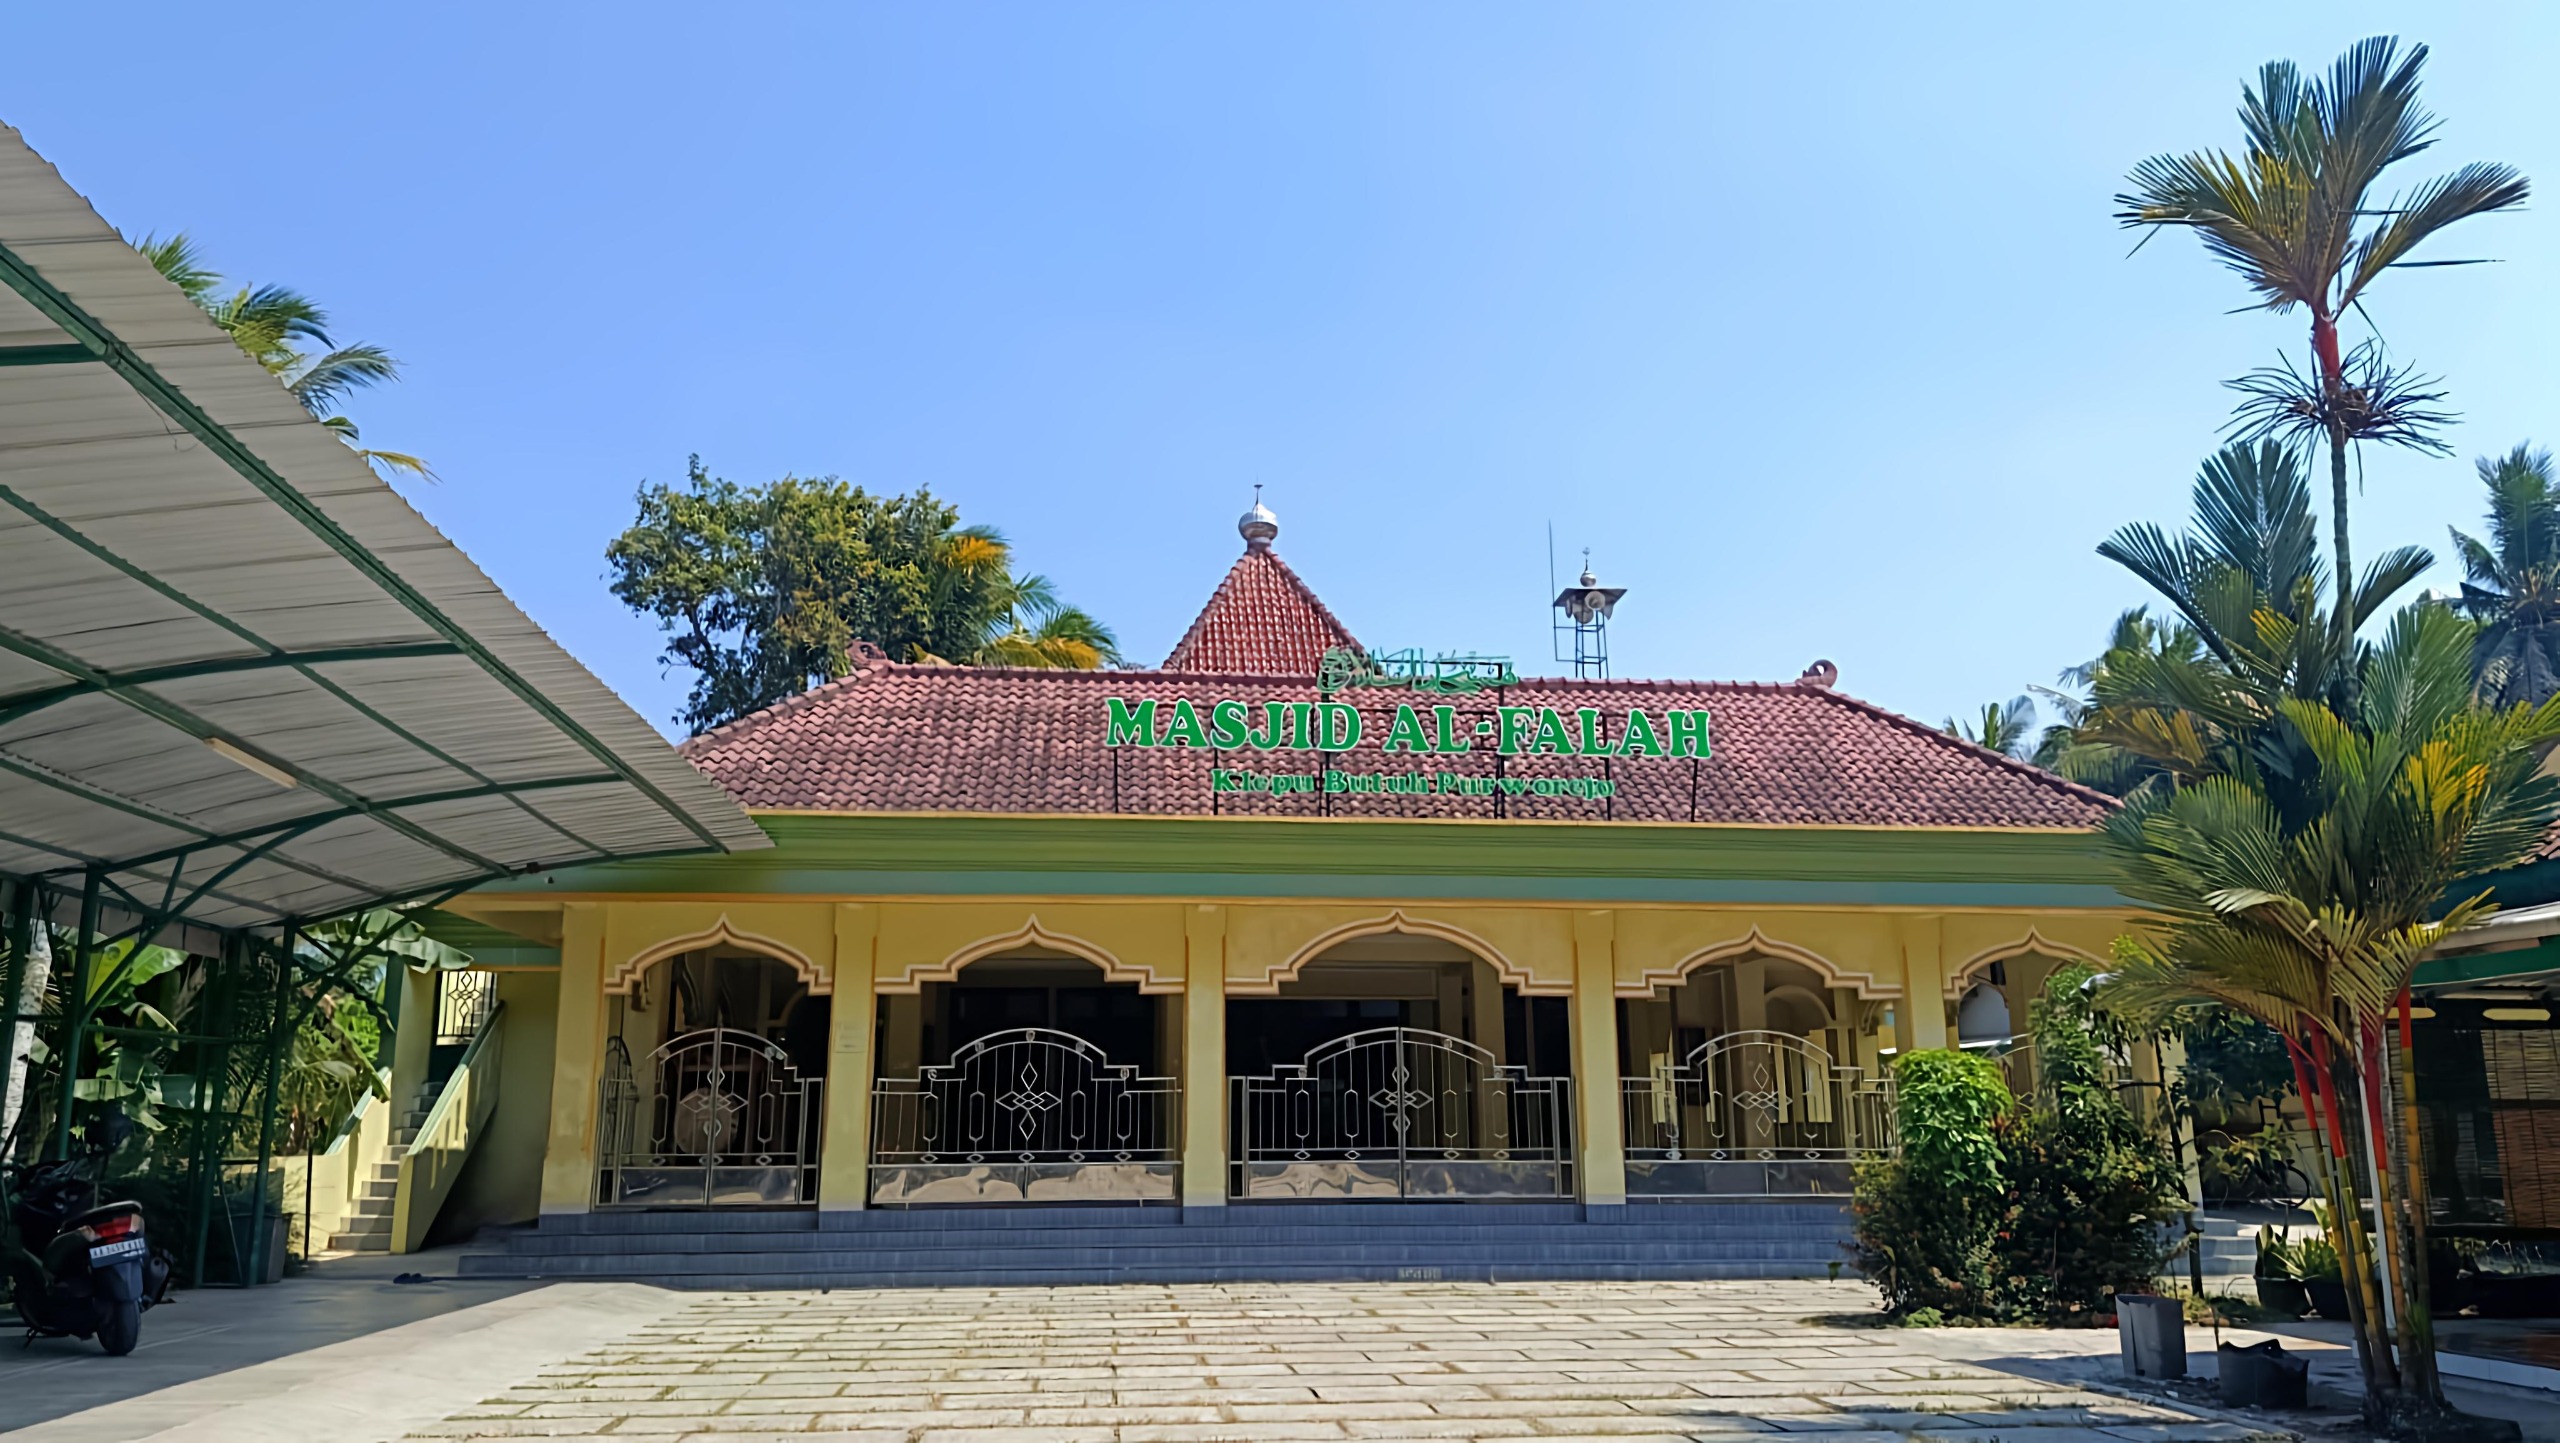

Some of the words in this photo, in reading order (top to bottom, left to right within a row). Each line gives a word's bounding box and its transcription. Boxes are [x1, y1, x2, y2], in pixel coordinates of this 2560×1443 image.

[1105, 697, 1362, 751] MASJID
[1383, 703, 1712, 758] AL-FALAH
[1211, 768, 1315, 797] Klepu
[1323, 769, 1429, 794] Butuh
